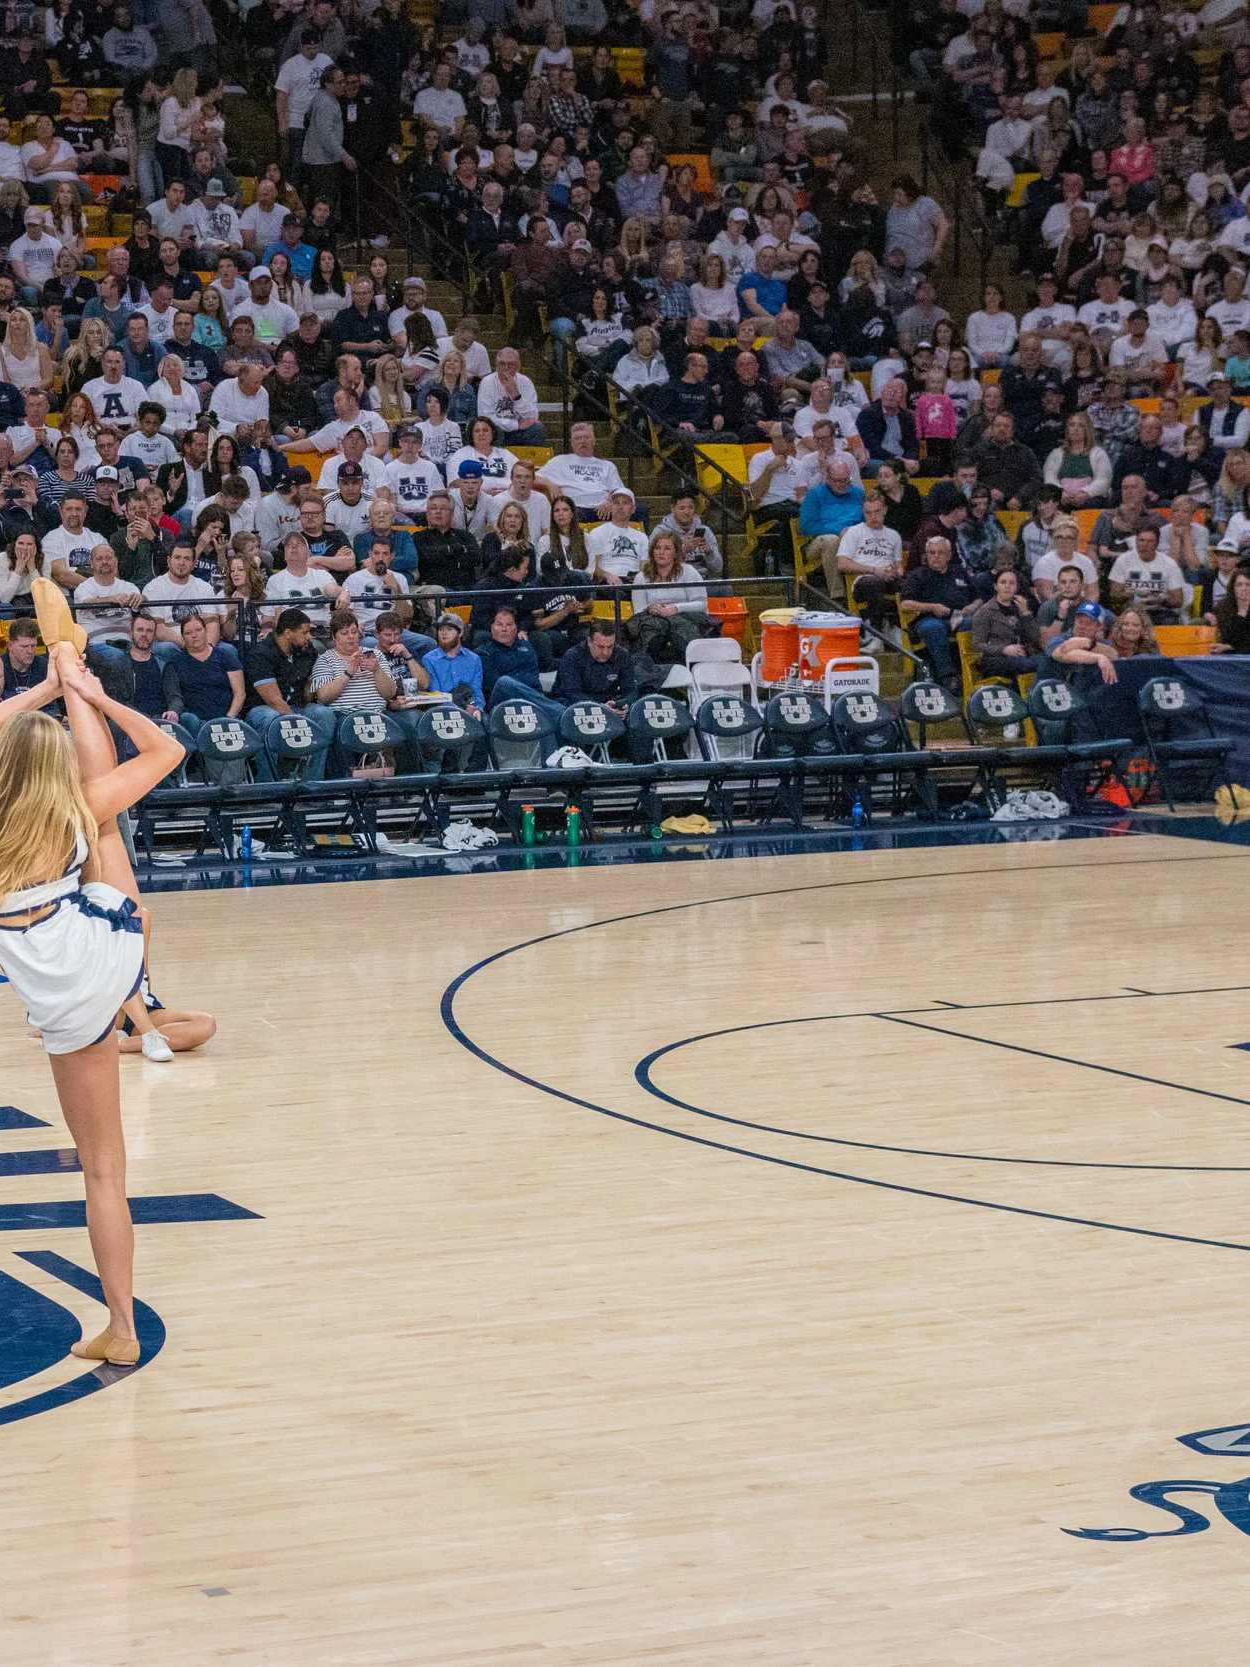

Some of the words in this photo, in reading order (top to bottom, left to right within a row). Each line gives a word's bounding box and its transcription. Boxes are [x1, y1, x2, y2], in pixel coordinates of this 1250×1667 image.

[100, 392, 129, 418] A
[481, 461, 508, 471] TATE
[399, 484, 429, 496] STATE
[1125, 580, 1163, 589] STATE
[833, 678, 870, 686] GATORADE
